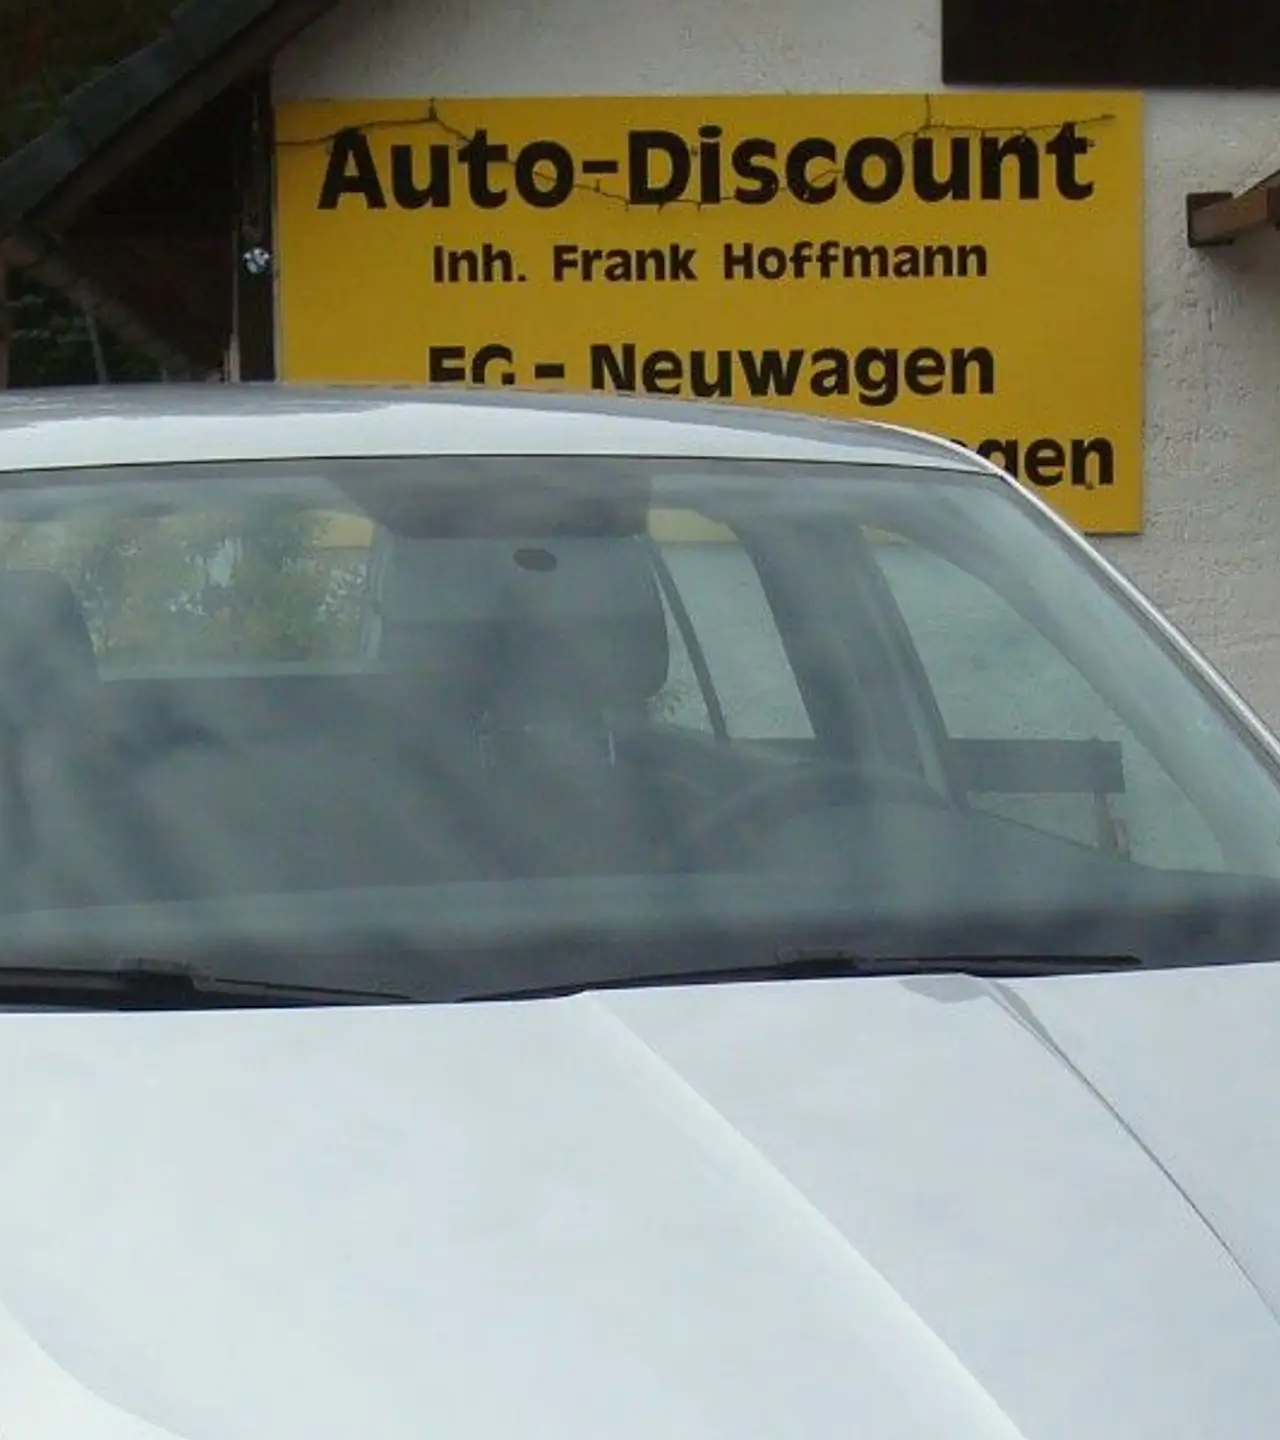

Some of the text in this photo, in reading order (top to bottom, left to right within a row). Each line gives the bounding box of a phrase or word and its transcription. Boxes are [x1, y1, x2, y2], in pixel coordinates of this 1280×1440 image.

[317, 124, 1094, 209] Auto-Discount
[432, 240, 988, 283] Inh. Frank Hoffmann
[590, 343, 995, 405] Neuwagen
